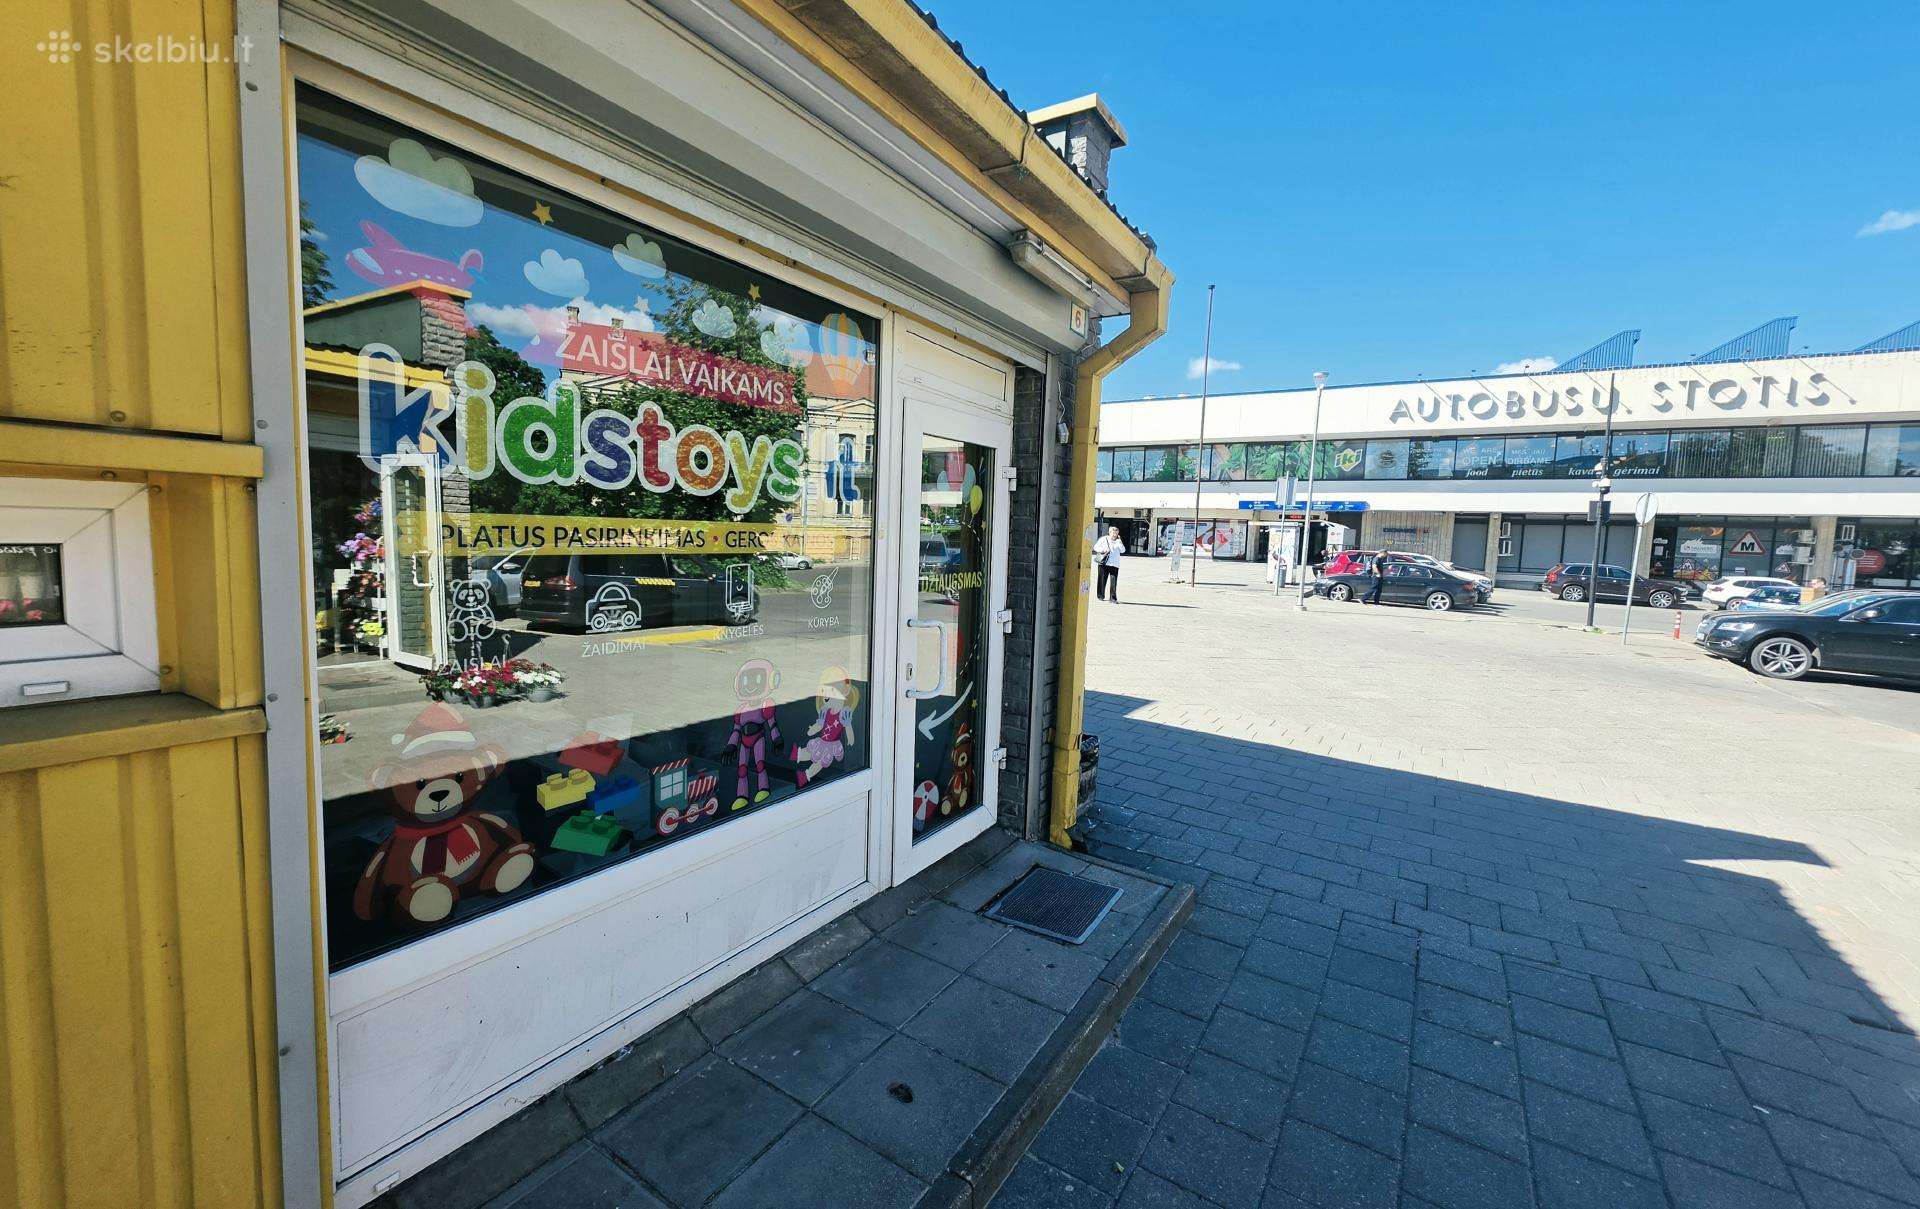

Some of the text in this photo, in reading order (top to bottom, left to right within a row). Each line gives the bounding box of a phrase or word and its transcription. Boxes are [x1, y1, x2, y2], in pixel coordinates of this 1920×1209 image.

[1075, 310, 1082, 329] 6
[554, 321, 785, 405] ŽAIŠLAI VAIKAMS
[1649, 372, 1831, 414] STOTIS
[358, 342, 803, 514] kidstoys
[1463, 456, 1497, 465] OPEN
[1466, 468, 1489, 478] food
[1568, 468, 1594, 476] kava
[1613, 466, 1660, 478] gėrimai
[441, 525, 546, 548] PLATUS
[554, 526, 706, 549] PASIRINKIMAS
